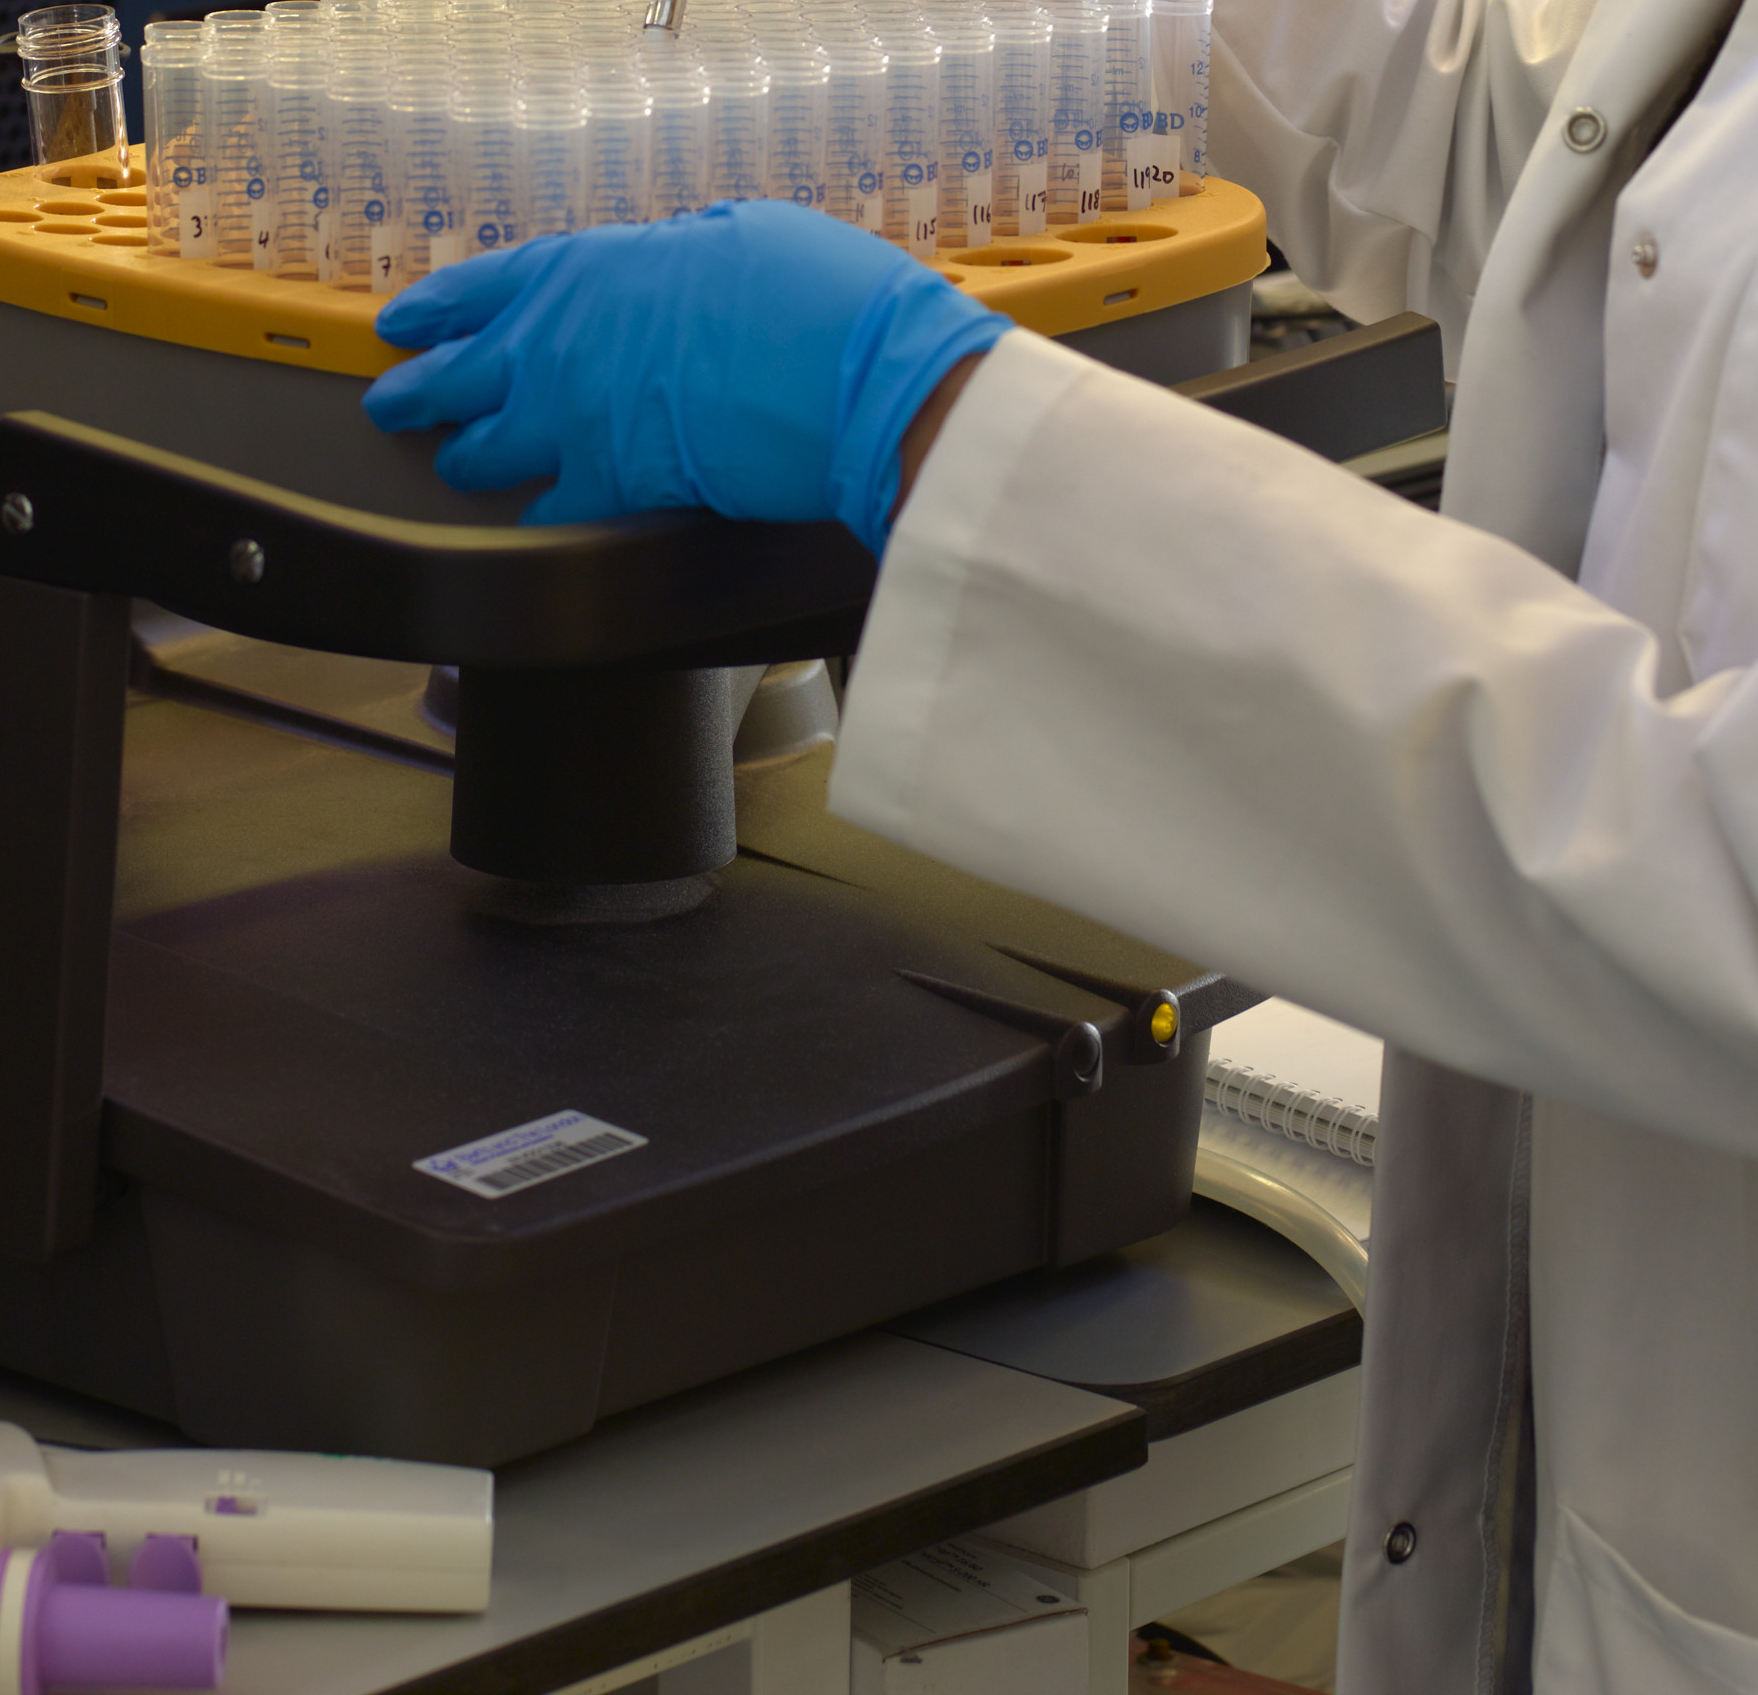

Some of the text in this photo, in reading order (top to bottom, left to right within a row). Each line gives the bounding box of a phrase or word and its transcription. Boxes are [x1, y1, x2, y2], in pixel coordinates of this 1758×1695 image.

[1191, 61, 1203, 75] 12
[1155, 111, 1185, 130] BD
[1189, 104, 1202, 119] 10
[1193, 149, 1201, 163] 8
[1025, 190, 1046, 213] 117
[1081, 189, 1100, 213] 118
[973, 204, 991, 225] 116
[191, 215, 203, 238] 3
[916, 217, 938, 242] 115
[258, 230, 270, 249] 4
[377, 255, 391, 277] 7
